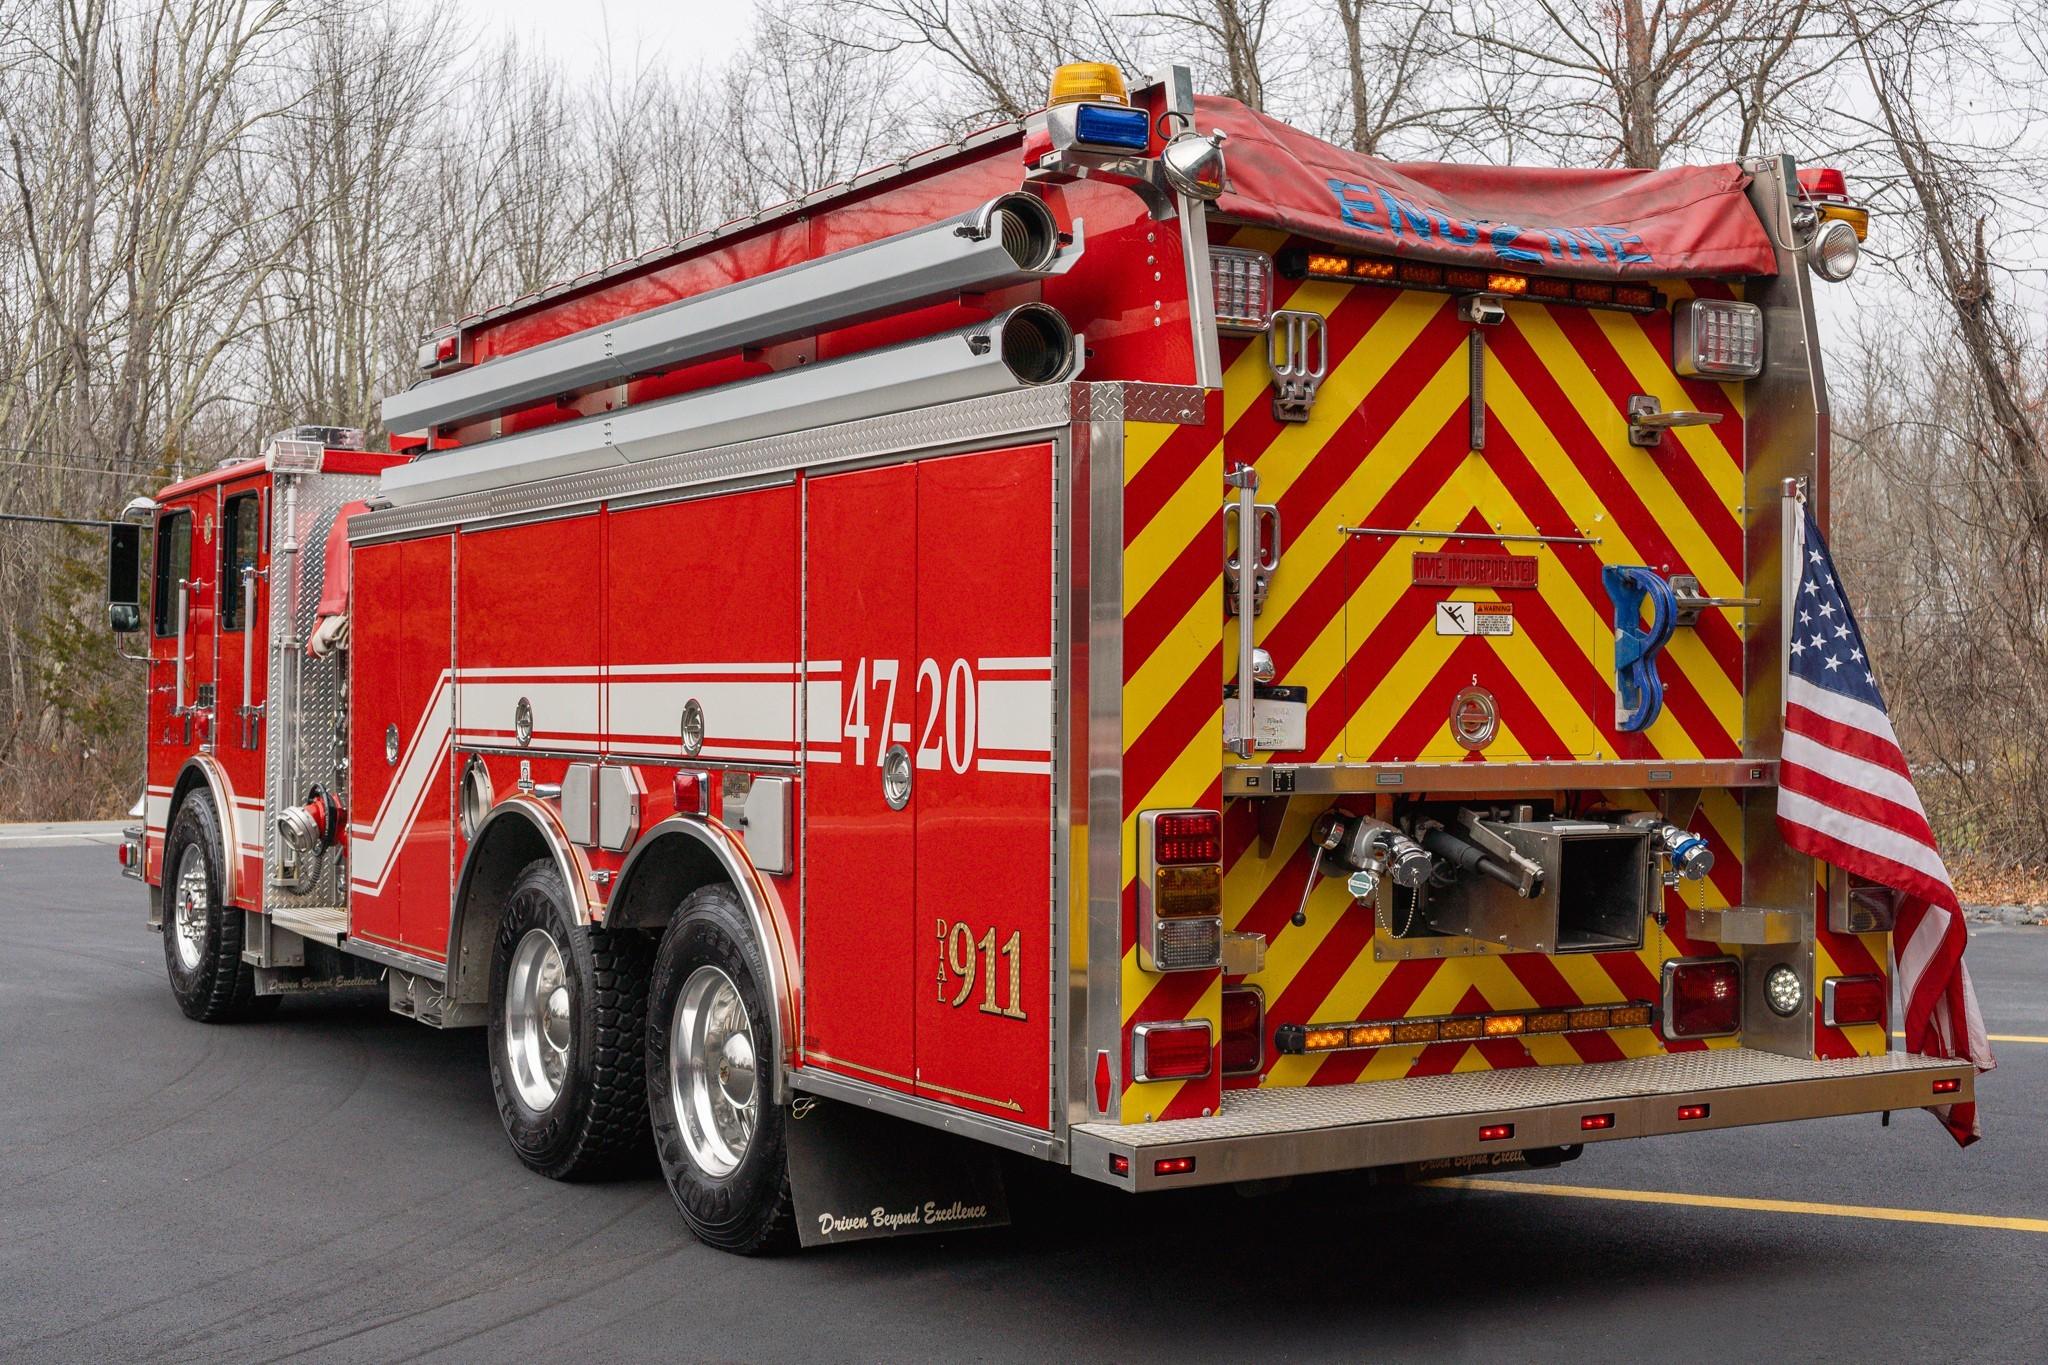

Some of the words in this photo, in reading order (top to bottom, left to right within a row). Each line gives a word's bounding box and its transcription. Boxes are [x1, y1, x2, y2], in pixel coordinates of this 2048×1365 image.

[1448, 558, 1536, 583] INCORPORATED
[1484, 605, 1511, 613] WARNING
[1471, 673, 1478, 687] 5
[844, 656, 976, 775] 47-20
[936, 918, 948, 1003] DIAL
[948, 921, 1028, 1022] 911
[818, 1212, 869, 1235] Driven
[871, 1206, 921, 1230] Beyond
[924, 1201, 987, 1225] Excellence
